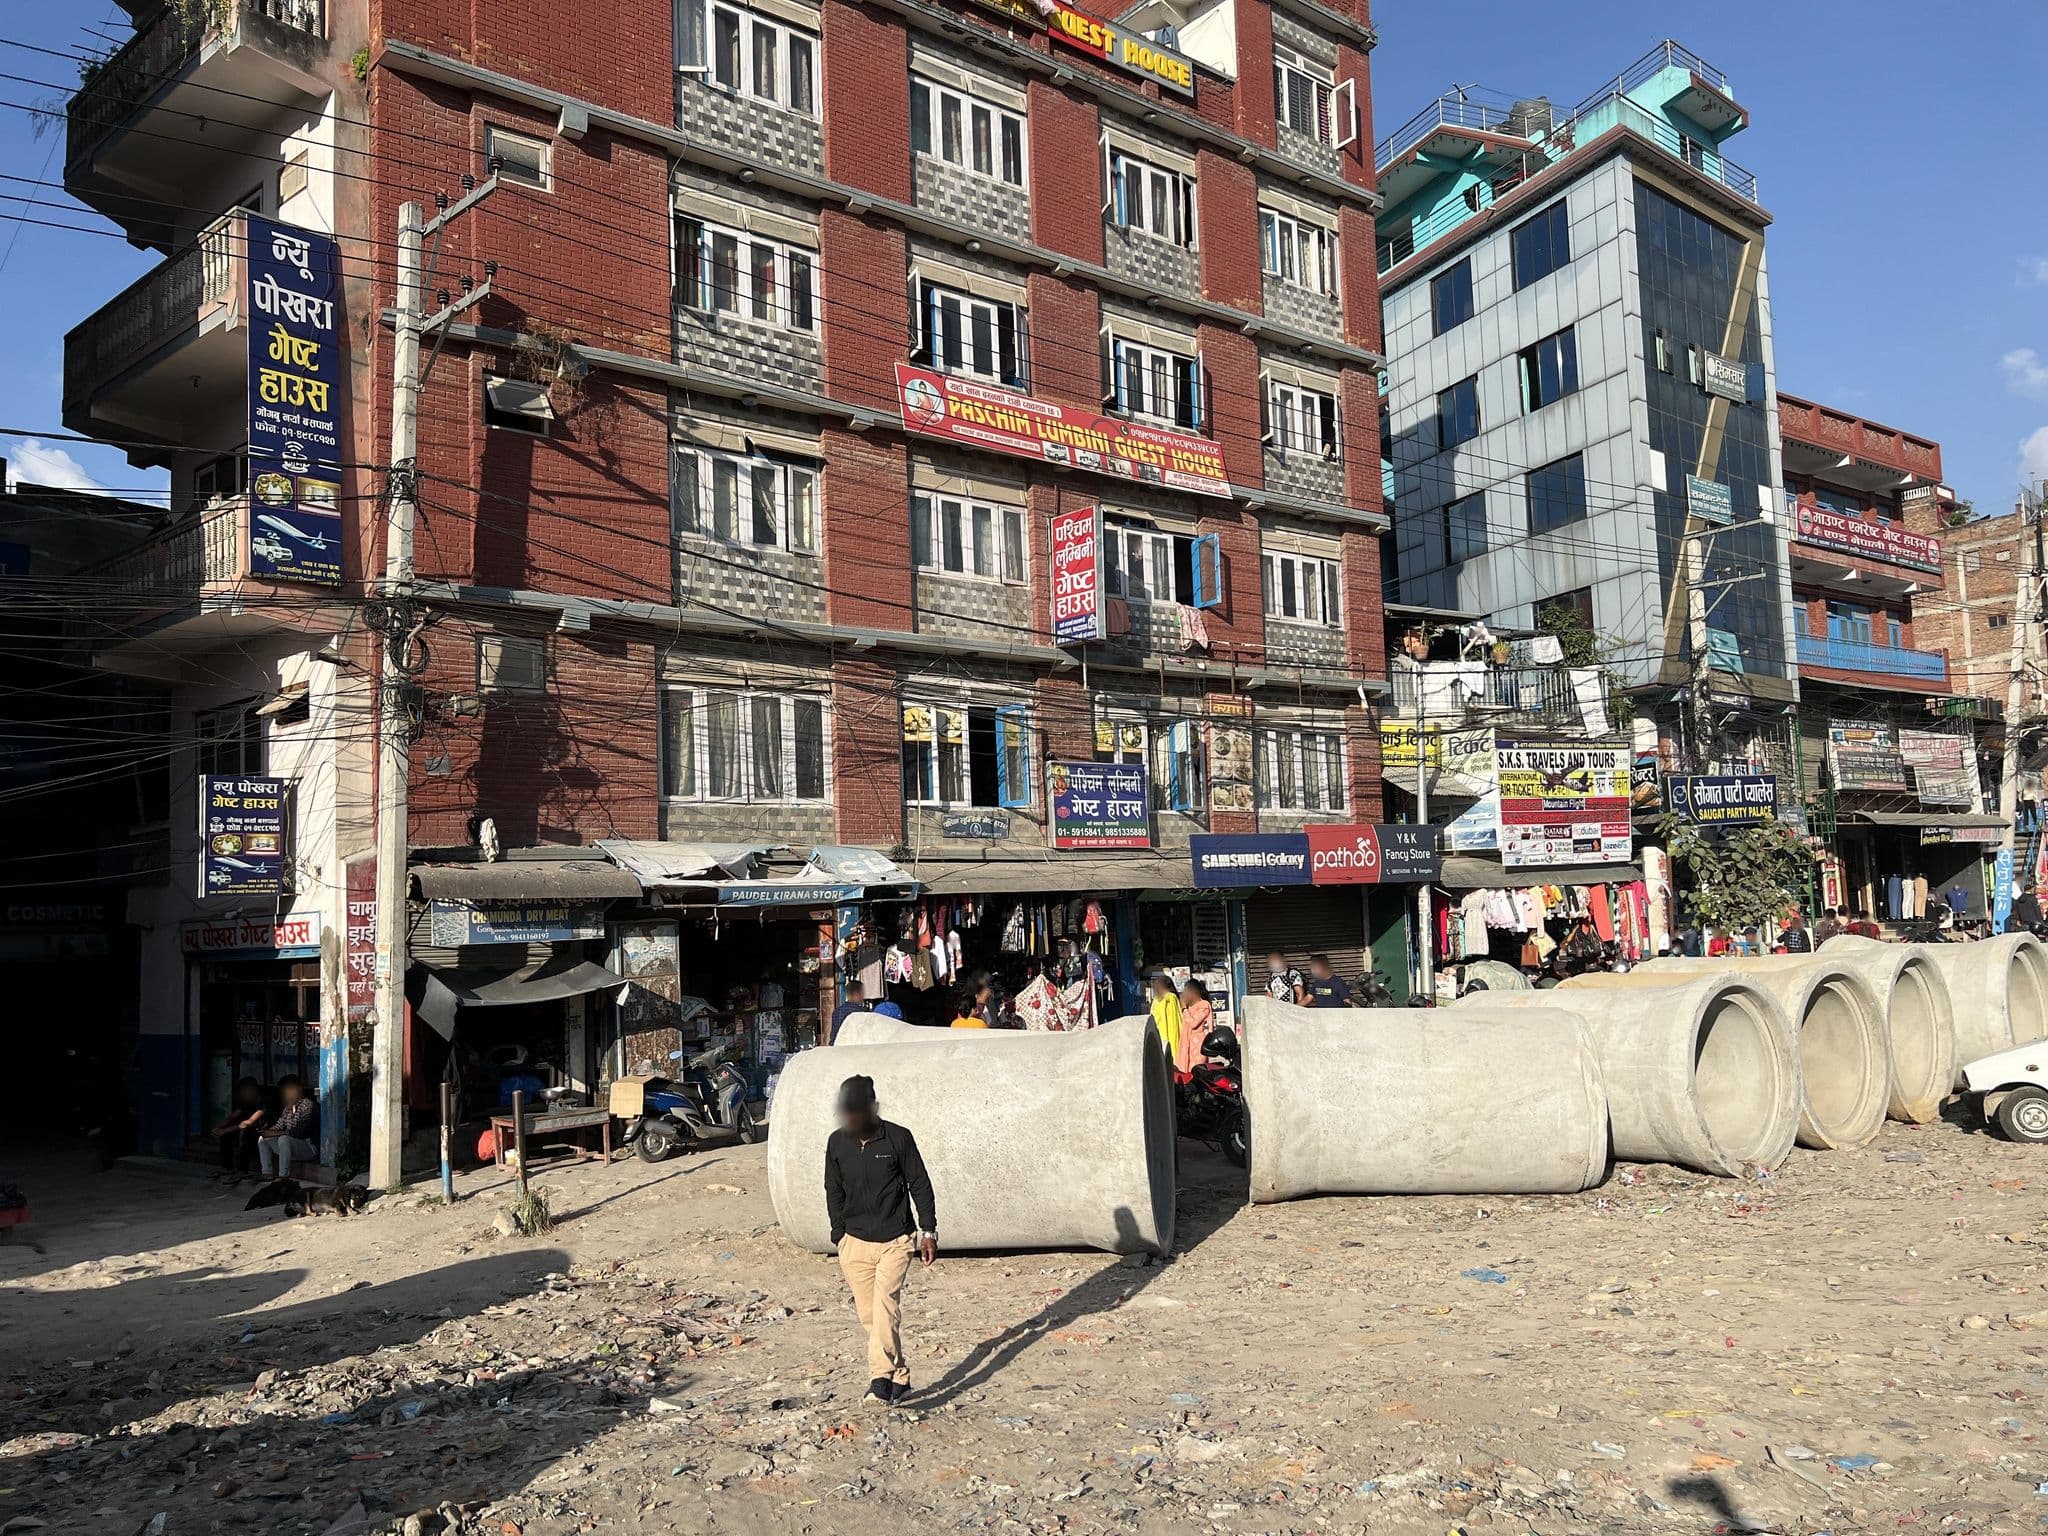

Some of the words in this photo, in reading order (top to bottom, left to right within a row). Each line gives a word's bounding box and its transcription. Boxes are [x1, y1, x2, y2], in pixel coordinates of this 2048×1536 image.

[1124, 38, 1192, 88] HOUSE
[271, 231, 314, 282] न्यू
[253, 273, 334, 330] पोखरा
[268, 322, 321, 371] गेष्ट
[259, 367, 329, 412] हाउस
[948, 395, 1032, 436] PASCHIM
[1036, 416, 1111, 454] LUMBINI
[1114, 436, 1166, 466] GUEST
[1171, 448, 1224, 478] HOUSE
[1055, 517, 1093, 542] पश्चिम
[1903, 532, 1928, 549] हाउस
[1056, 537, 1094, 569] लुम्बिनी
[1056, 569, 1095, 595] गेष्ट
[1056, 590, 1095, 619] हाउस
[1499, 751, 1525, 768] S.K.S.
[1526, 752, 1565, 769] TRAVELS
[1567, 752, 1585, 768] AND
[1587, 751, 1615, 769] TOURS
[212, 781, 235, 795] न्यू
[238, 779, 279, 794] पोखरा
[1500, 784, 1510, 796] AIR
[1511, 783, 1534, 796] TICKET
[1745, 777, 1773, 803] प्यालेस
[212, 794, 240, 808] गेष्ट
[243, 797, 279, 809] हाउस
[1071, 794, 1101, 816] गेष्ट
[1106, 800, 1142, 820] हाउस
[1544, 799, 1568, 809] Mountain
[1699, 809, 1725, 820] SAUGAT
[1727, 807, 1747, 819] PARTY
[1748, 805, 1772, 818] PALACE
[1396, 832, 1403, 844] Y
[1403, 832, 1410, 844] &
[1411, 832, 1417, 844] K
[1202, 853, 1263, 869] SAMSUNG
[1267, 853, 1305, 870] Galaxy
[1313, 845, 1376, 871] pathao
[1385, 848, 1409, 862] Fancy
[1410, 848, 1431, 859] Store
[732, 891, 771, 901] PAUDEL
[773, 891, 810, 900] KIRANA
[812, 890, 844, 900] STORE
[471, 910, 522, 924] CHAMUNDA
[526, 910, 546, 922] DRY
[547, 908, 569, 921] MEAT
[273, 921, 310, 946] हाउस
[510, 933, 550, 942] 9841160197
